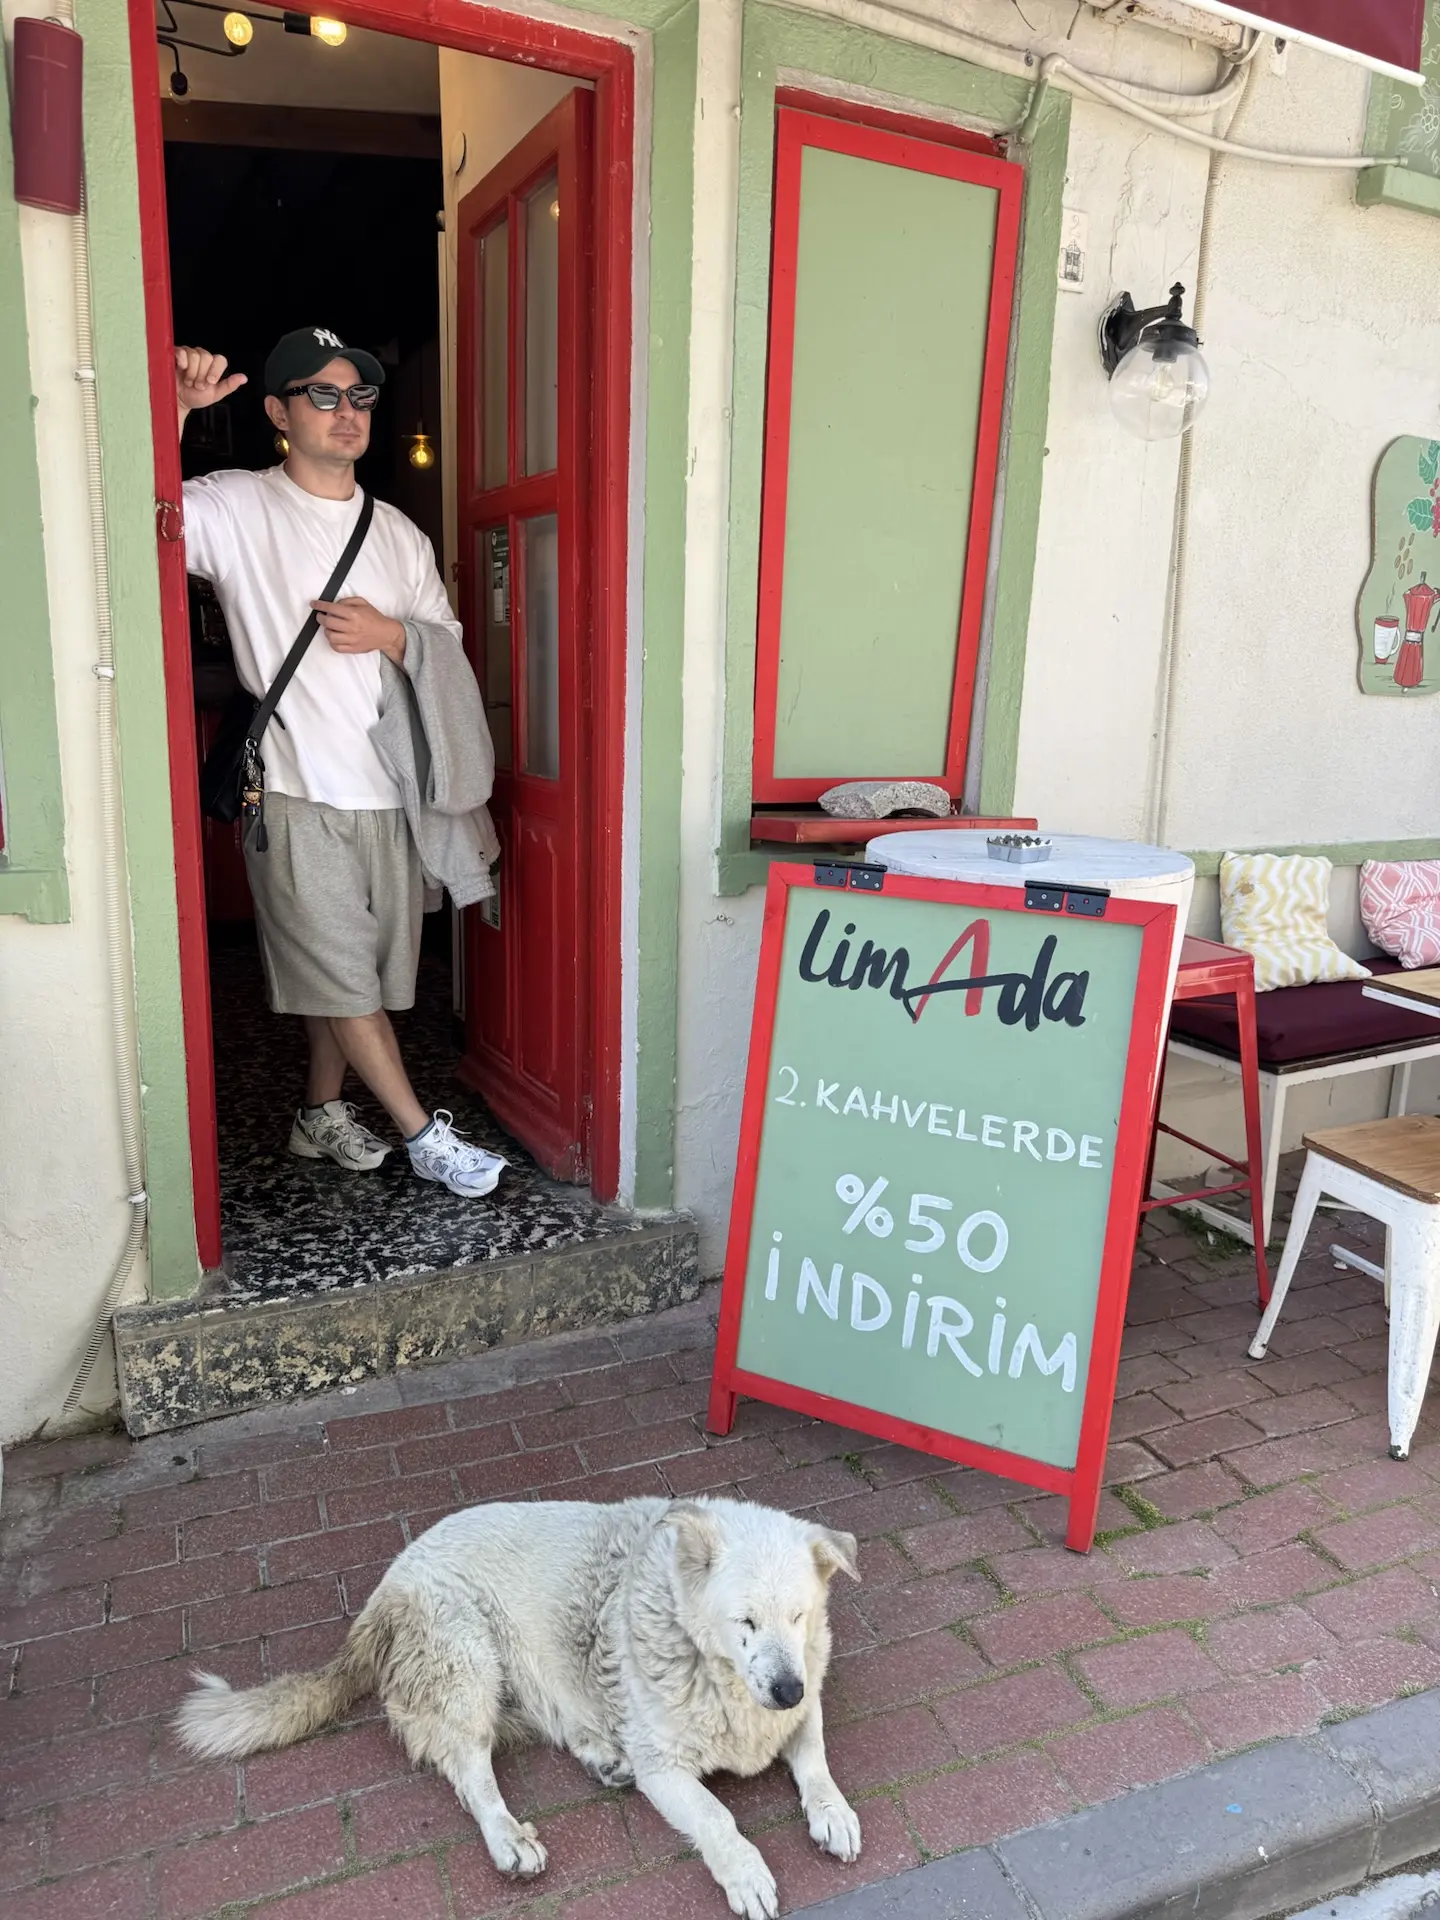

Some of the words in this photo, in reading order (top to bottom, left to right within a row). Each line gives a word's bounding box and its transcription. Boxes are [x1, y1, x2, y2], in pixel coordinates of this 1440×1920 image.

[313, 328, 344, 348] NY
[775, 1066, 806, 1109] 2.
[817, 1078, 1104, 1169] KAHVELERDE
[835, 1173, 1009, 1273] %50
